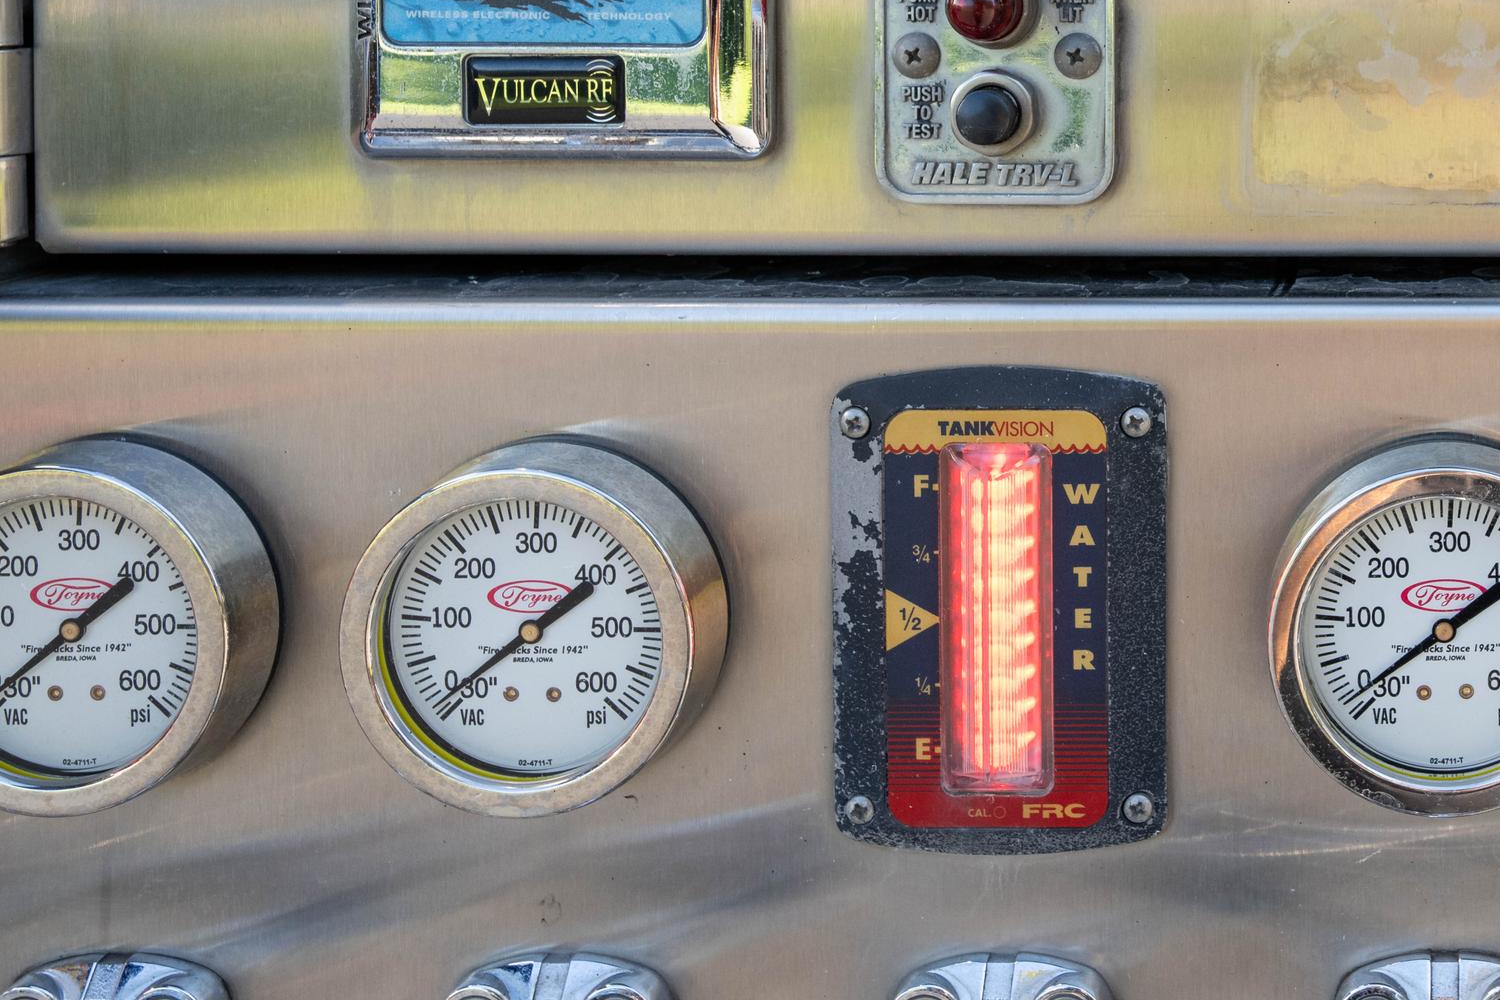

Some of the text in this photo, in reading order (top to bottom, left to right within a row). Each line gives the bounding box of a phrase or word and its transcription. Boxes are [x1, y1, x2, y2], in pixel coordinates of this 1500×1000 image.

[406, 10, 672, 20] WIRELESS ELECTRONIC TECHNOLOGY
[907, 7, 936, 21] HOT
[474, 78, 613, 115] VULCAN RF
[912, 162, 1078, 186] HALE TRV-L
[938, 421, 1054, 436] TANKVISION
[516, 533, 557, 553] 300
[1063, 483, 1100, 671] WATER
[1368, 558, 1409, 578] 200
[1416, 585, 1474, 606] Toyne
[432, 608, 471, 628] 100
[576, 672, 616, 693] 600
[460, 709, 484, 725] VAC
[1022, 804, 1086, 818] FRC
